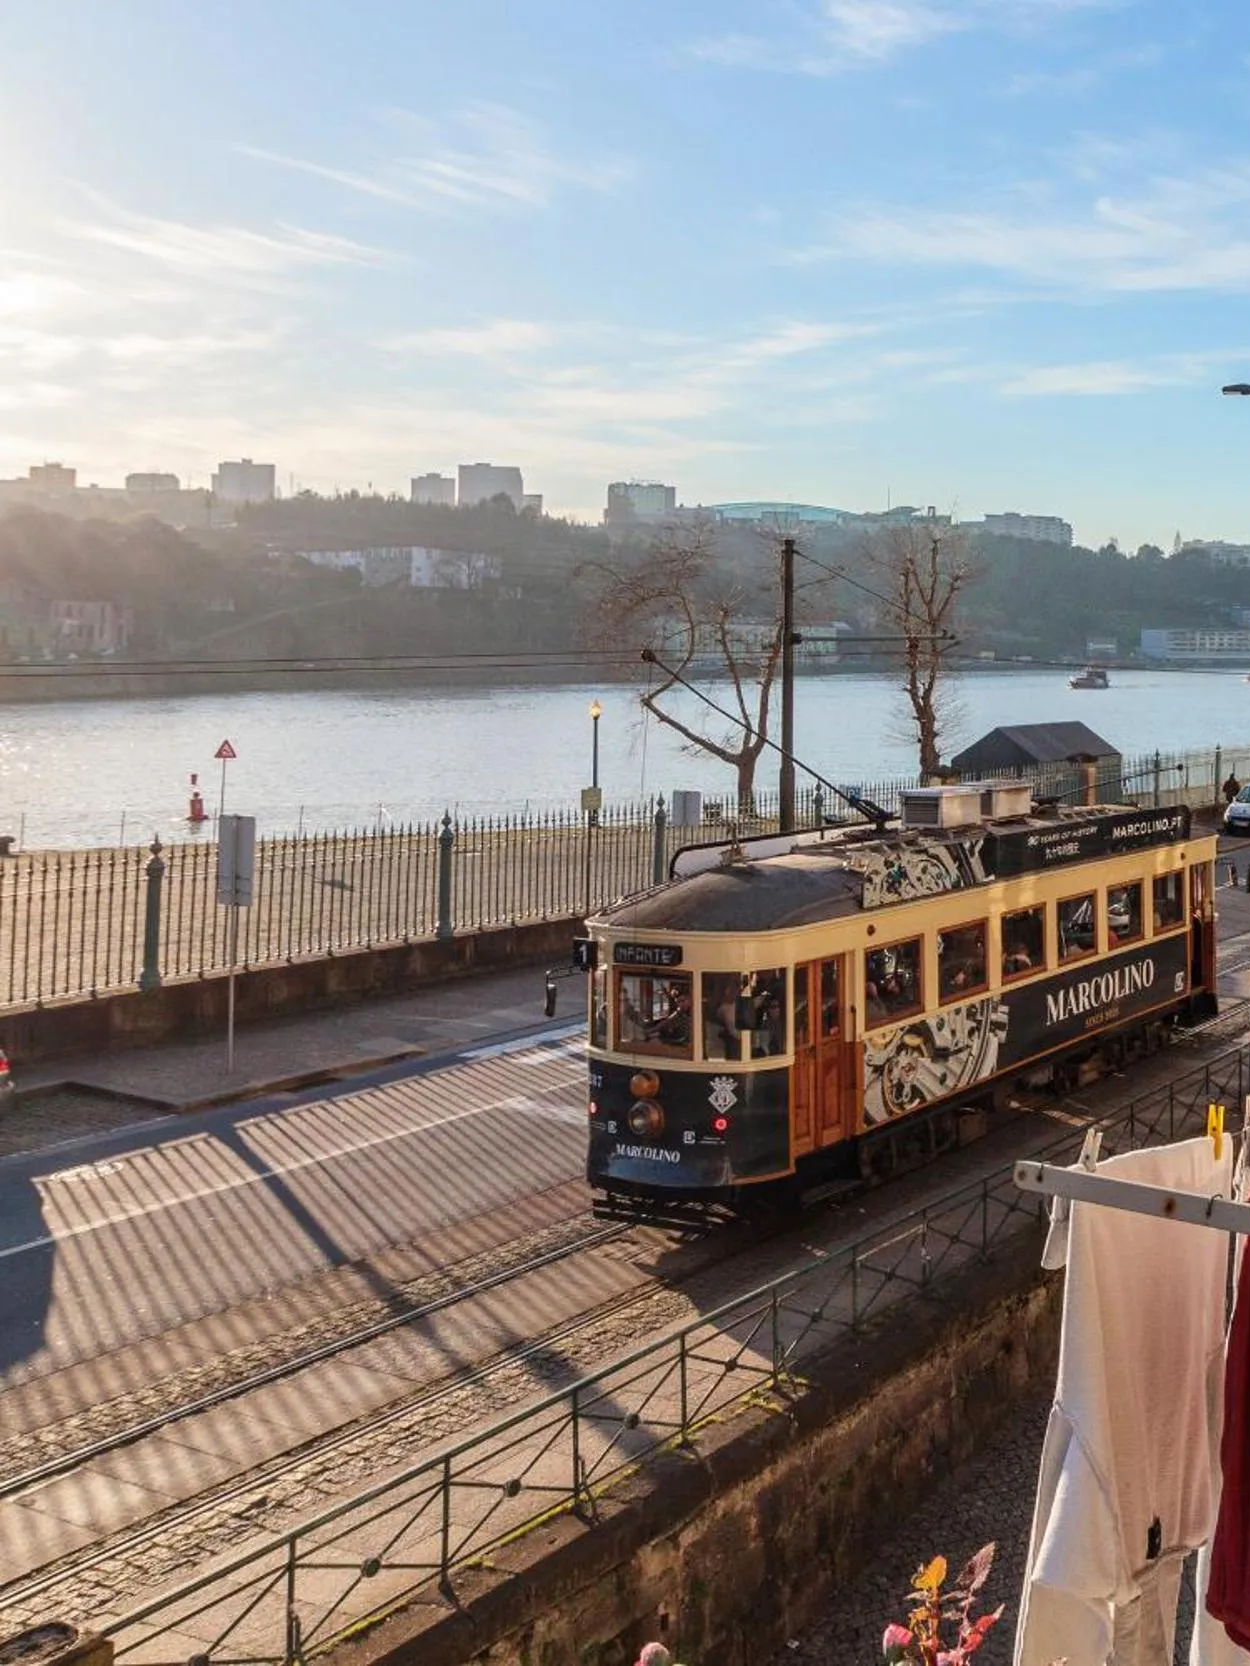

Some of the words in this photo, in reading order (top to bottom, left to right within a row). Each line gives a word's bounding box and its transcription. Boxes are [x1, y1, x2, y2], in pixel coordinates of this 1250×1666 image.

[1040, 832, 1060, 844] YEARS
[1061, 831, 1071, 839] OF
[1072, 826, 1098, 838] HISTORY
[1112, 815, 1182, 839] MARCOLINO.PT
[579, 945, 588, 963] 1
[615, 946, 673, 964] INFANTE
[1045, 958, 1155, 1027] MARCOLINO
[615, 1143, 681, 1164] MARCOLINO
